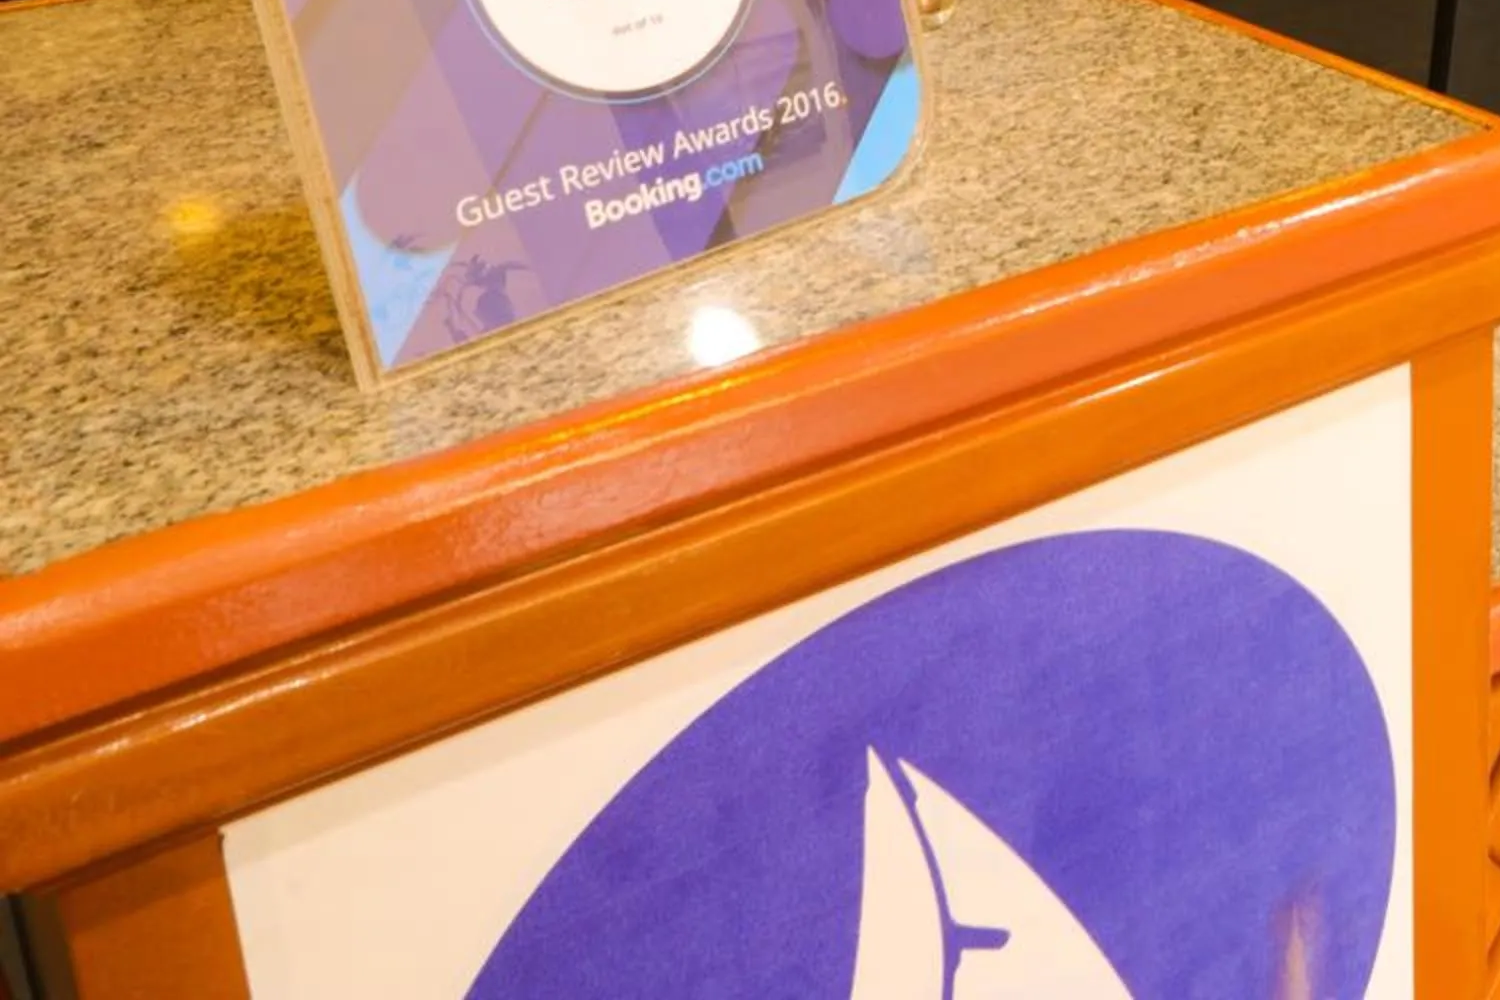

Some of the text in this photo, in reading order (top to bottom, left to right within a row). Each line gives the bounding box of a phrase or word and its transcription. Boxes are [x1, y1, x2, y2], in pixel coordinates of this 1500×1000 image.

[456, 81, 842, 228] Guest Review Awards 2016
[585, 149, 765, 229] Booking.com
